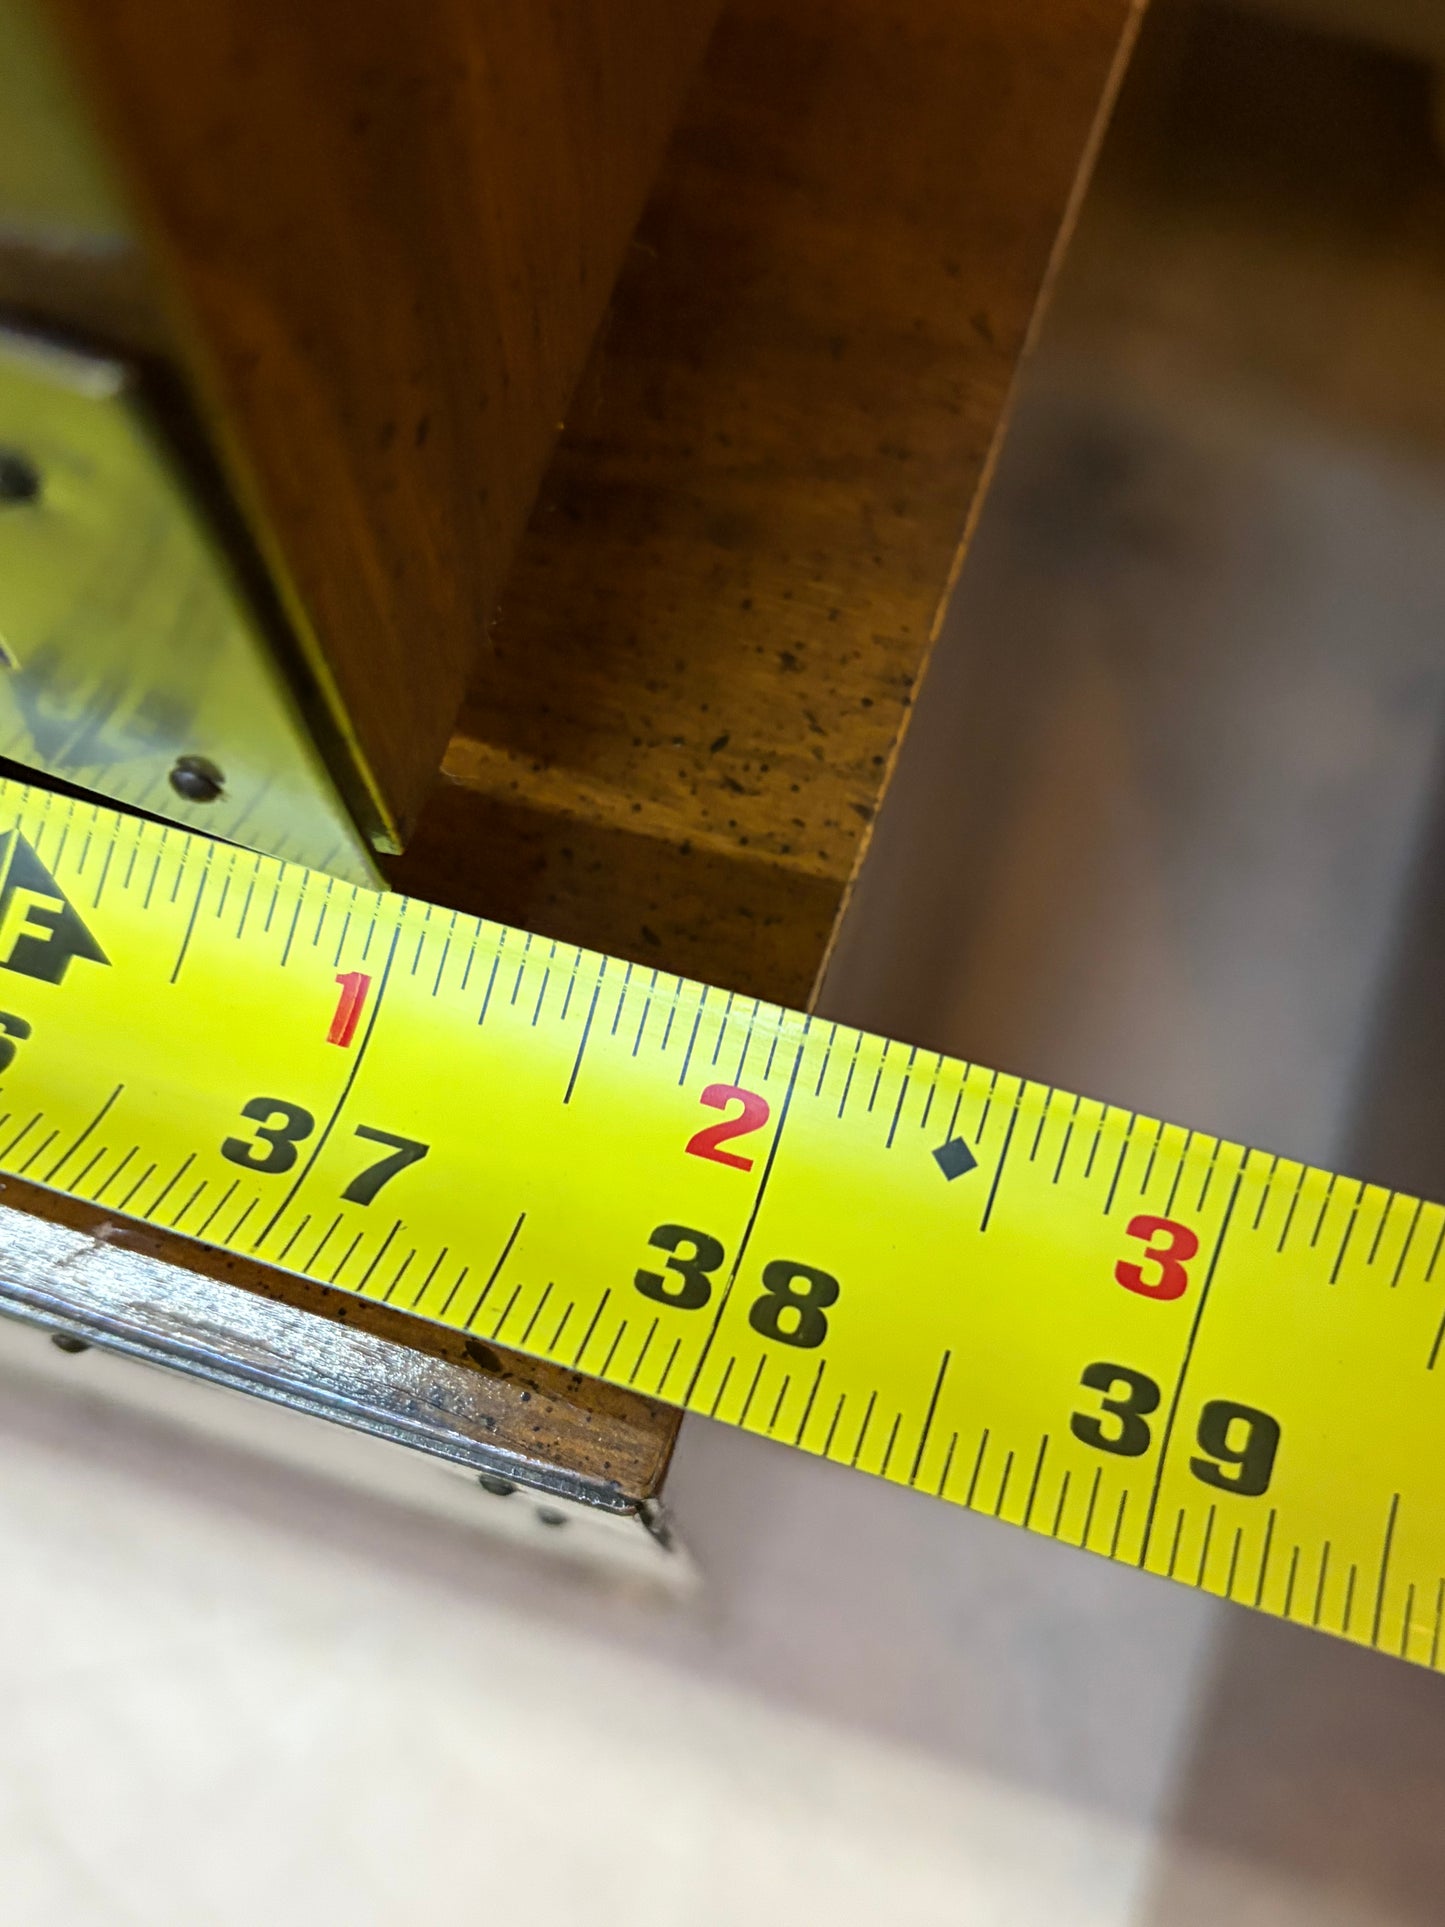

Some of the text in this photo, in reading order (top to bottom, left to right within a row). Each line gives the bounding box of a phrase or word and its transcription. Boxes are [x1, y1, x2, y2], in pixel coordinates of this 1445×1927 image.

[326, 971, 372, 1048] 1
[685, 1083, 771, 1172] 2
[1114, 1214, 1199, 1301] 3
